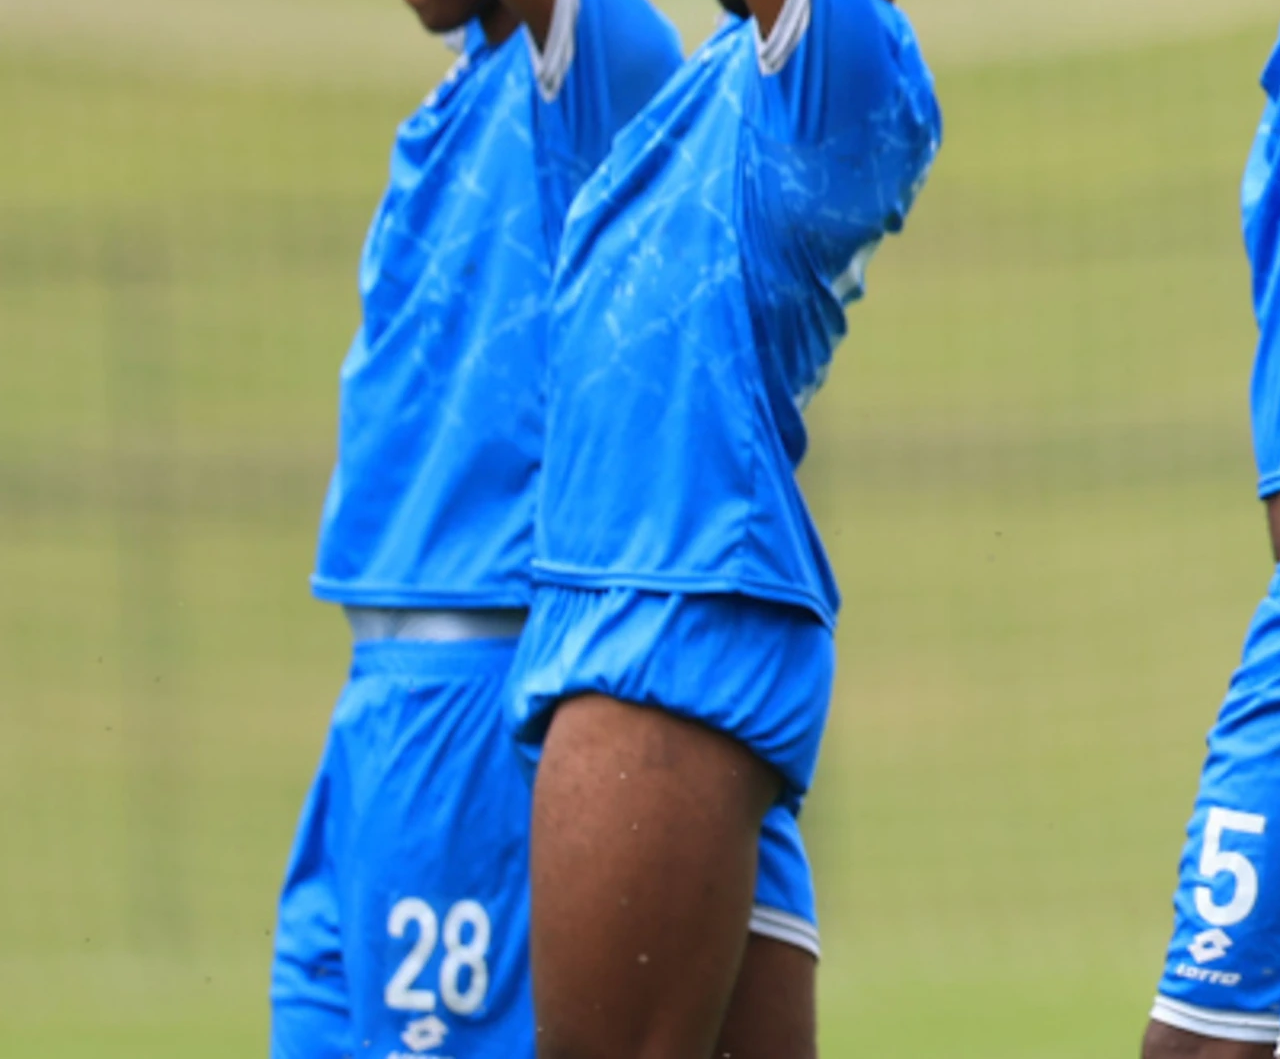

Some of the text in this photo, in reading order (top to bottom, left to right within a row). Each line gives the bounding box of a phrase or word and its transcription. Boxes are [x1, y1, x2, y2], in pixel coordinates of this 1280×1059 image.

[1192, 805, 1266, 927] 5
[385, 897, 490, 1013] 28
[1175, 962, 1242, 987] LOTTO
